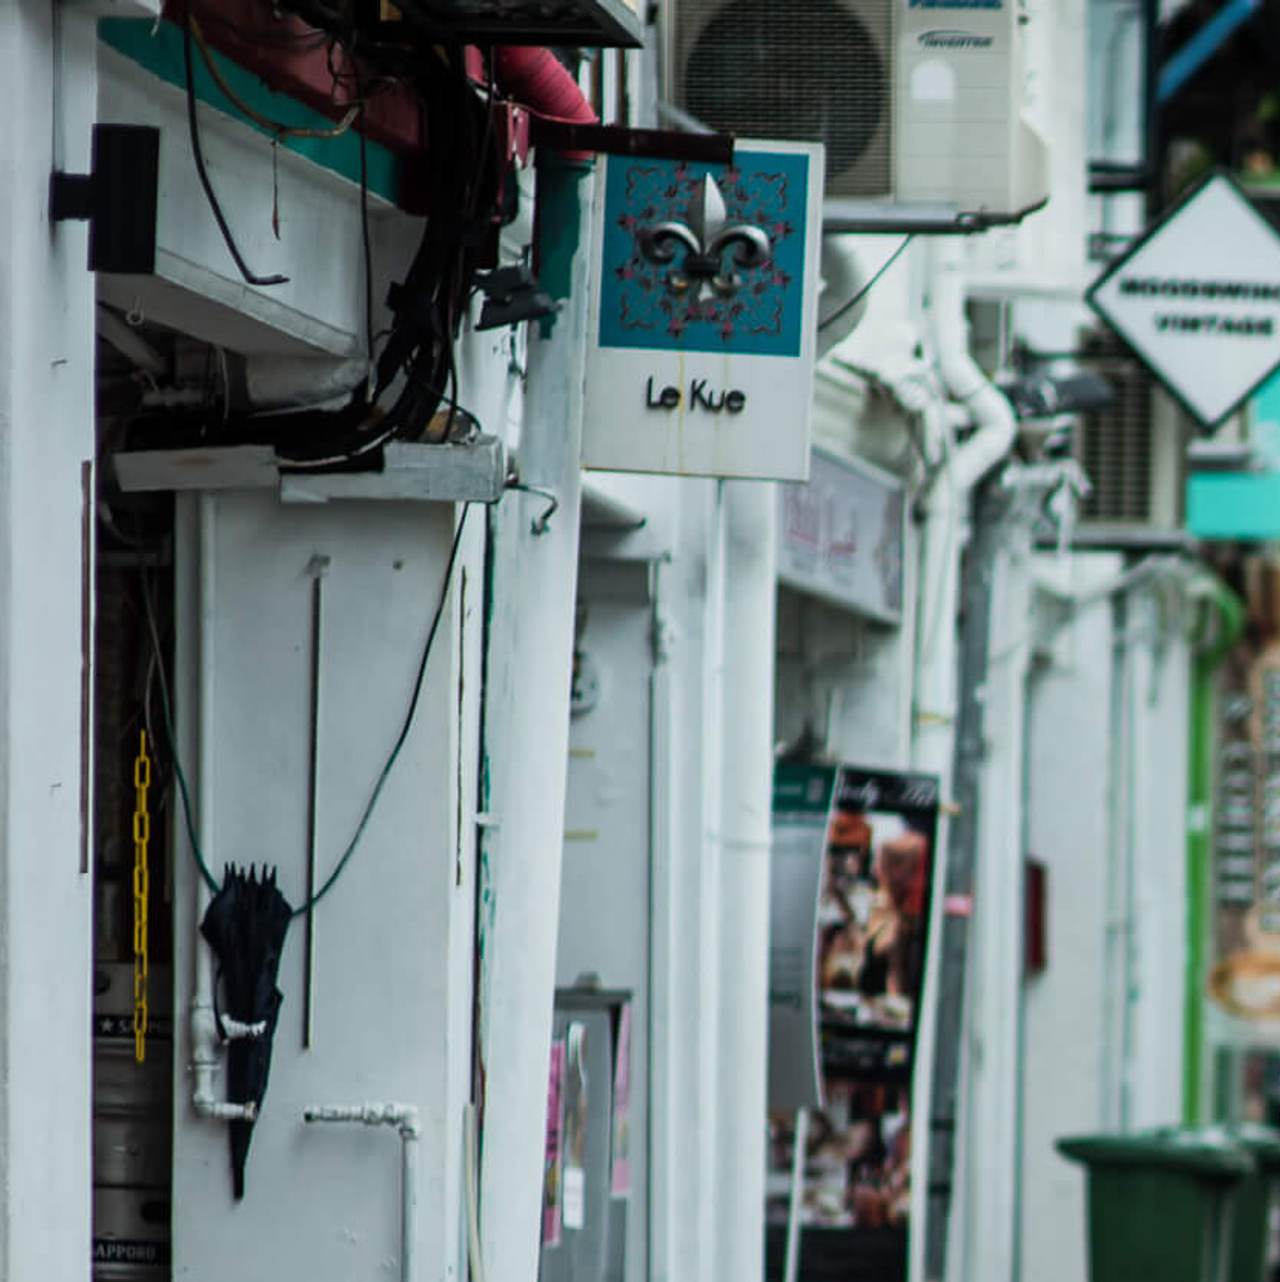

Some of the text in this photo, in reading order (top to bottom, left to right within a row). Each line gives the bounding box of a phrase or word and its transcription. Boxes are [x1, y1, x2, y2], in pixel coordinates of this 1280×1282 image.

[1156, 316, 1274, 336] VINTAGE
[646, 375, 746, 413] Le Kue
